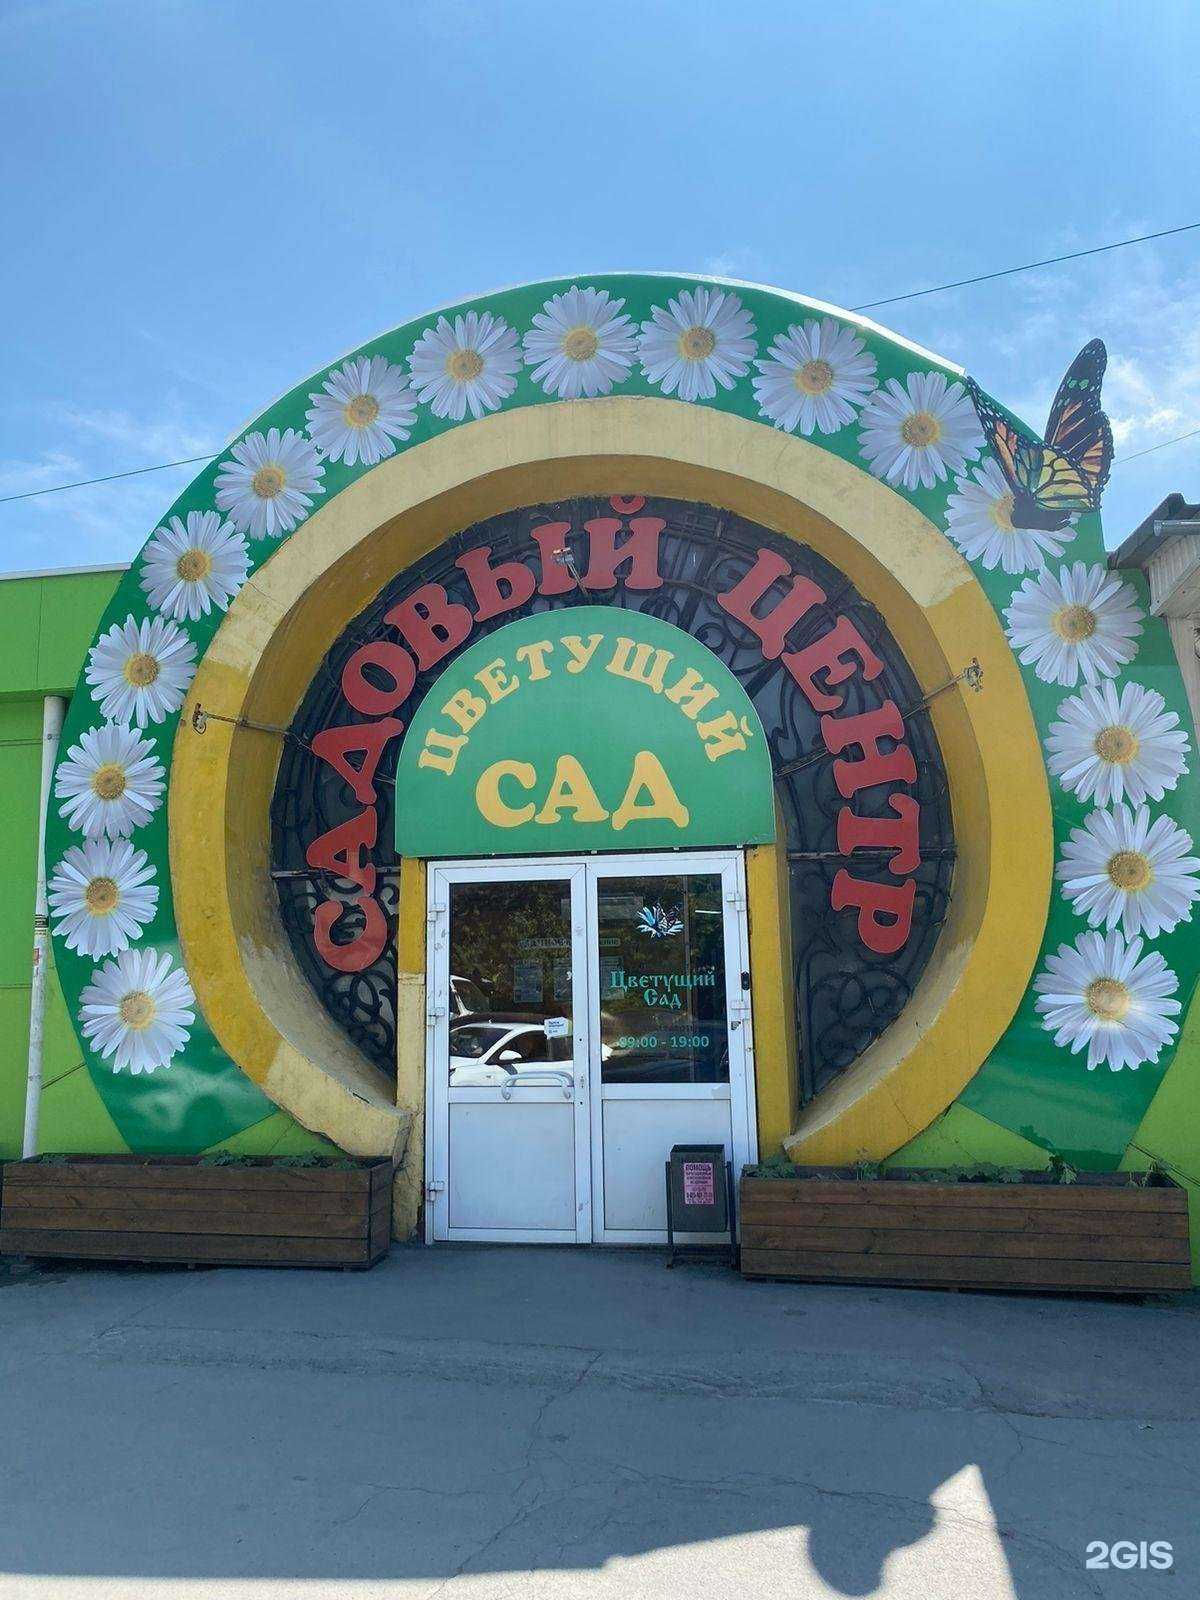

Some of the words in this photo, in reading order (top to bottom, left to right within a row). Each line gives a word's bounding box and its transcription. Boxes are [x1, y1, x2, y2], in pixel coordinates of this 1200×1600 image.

[419, 634, 754, 776] ЦВЕТУЩИЙ
[306, 494, 666, 972] САДОВЫЙ
[718, 549, 919, 954] ЦЕНТР
[475, 750, 690, 831] САД
[610, 970, 715, 992] Цветущий
[643, 988, 682, 1009] Сад
[619, 1036, 658, 1048] 09:00
[671, 1036, 710, 1048] 19:00
